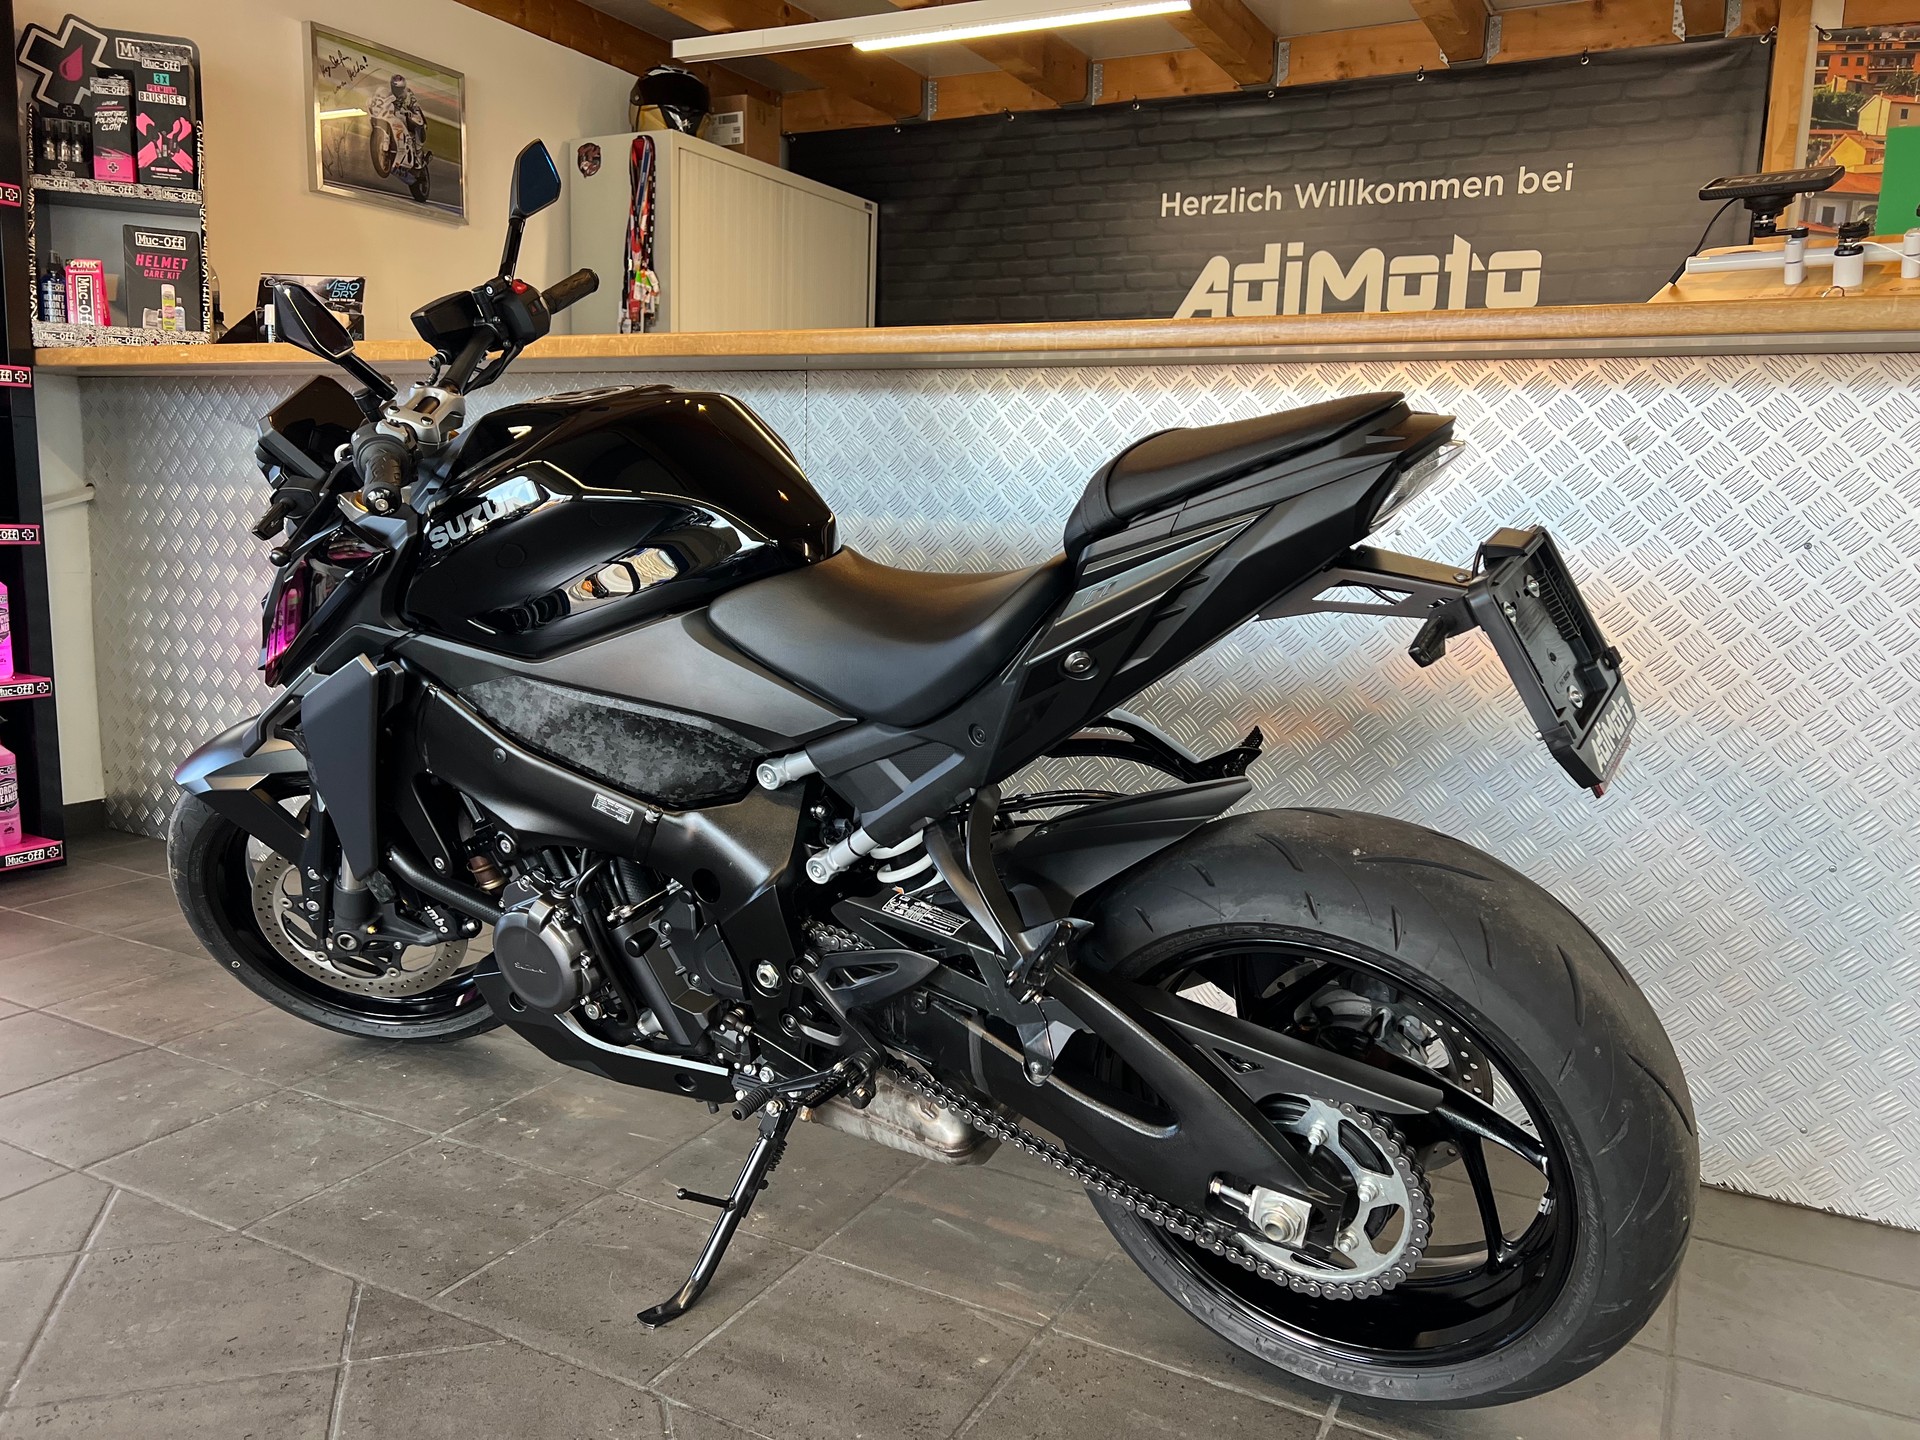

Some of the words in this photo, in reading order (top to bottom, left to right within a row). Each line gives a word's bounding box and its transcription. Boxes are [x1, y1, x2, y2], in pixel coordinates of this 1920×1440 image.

[143, 58, 180, 71] Muc-Off
[139, 92, 168, 104] BRUSH
[169, 95, 186, 106] SET
[1161, 184, 1282, 218] Herzlich
[1294, 170, 1504, 209] Willkommen
[1517, 162, 1575, 195] bei
[137, 234, 184, 249] Muc-Off
[70, 260, 97, 269] PUNK
[135, 253, 188, 271] HELMET
[143, 269, 165, 279] CARE
[167, 271, 182, 280] KIT
[1173, 234, 1542, 319] AdiMoto
[326, 279, 360, 291] VISIO
[331, 290, 358, 298] DRY
[7, 850, 43, 867] Muc-Off
